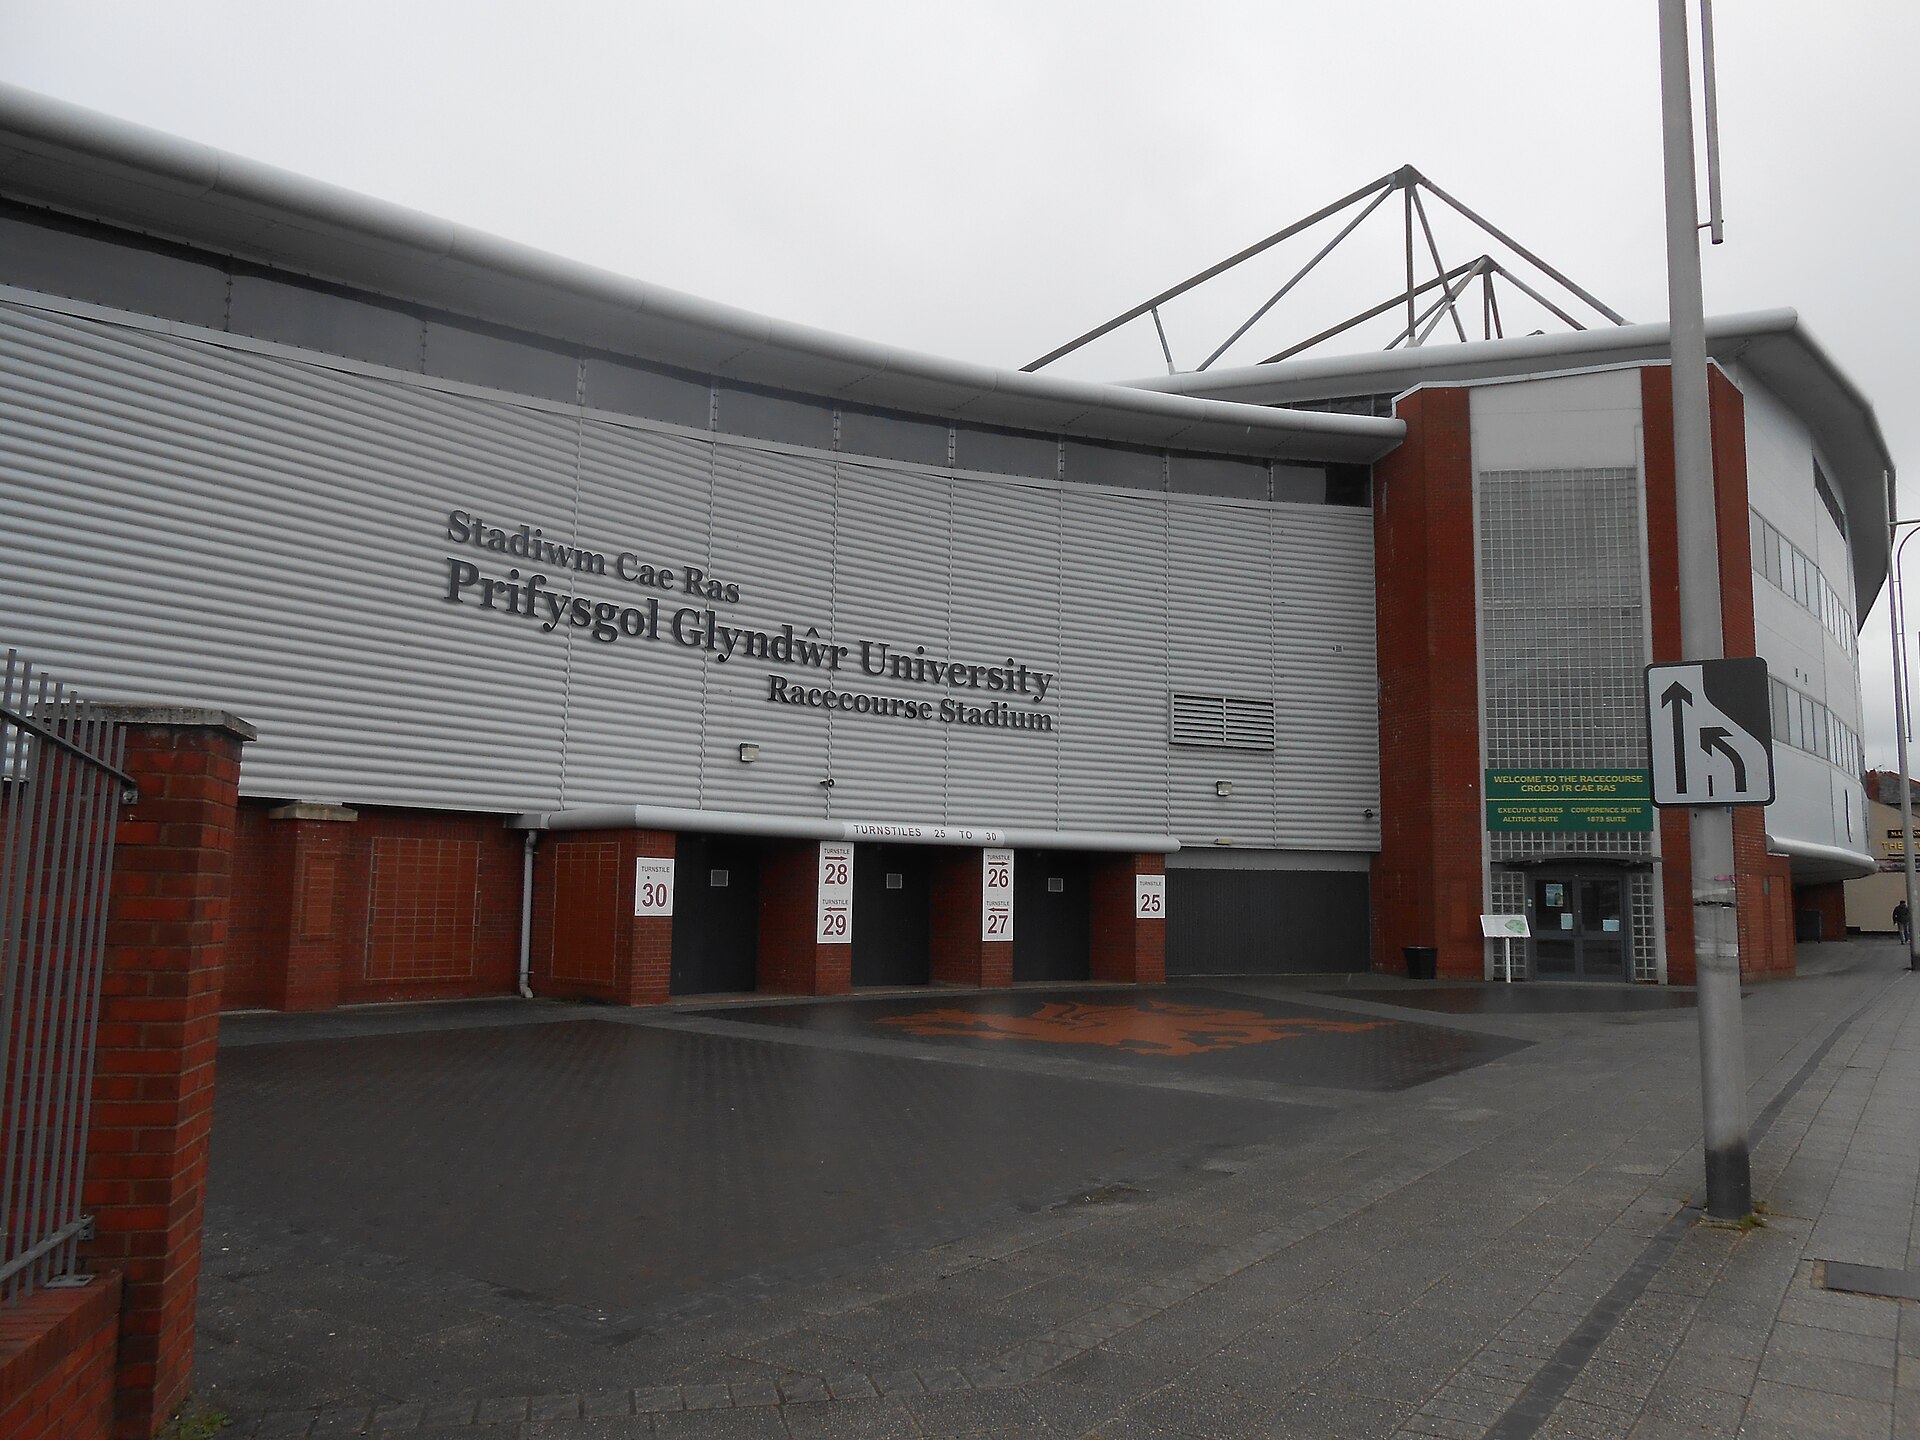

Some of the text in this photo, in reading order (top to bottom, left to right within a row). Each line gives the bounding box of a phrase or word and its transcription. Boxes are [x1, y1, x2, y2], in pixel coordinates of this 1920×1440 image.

[447, 509, 740, 604] Stadiwm Cae Ras
[444, 556, 1053, 703] Prifysgol Glyndŵr University
[768, 674, 1053, 731] Racecourse Stadium
[1494, 775, 1643, 783] WELCOME TO THE RACECOURSE
[1521, 784, 1559, 792] CROESO
[1574, 784, 1594, 792] CAE
[1597, 784, 1616, 792] RAS
[853, 824, 997, 841] TURNSTILES 25 TO 30
[823, 847, 850, 855] TURNSTILE
[641, 865, 670, 873] TURNSTILE
[824, 863, 848, 885] 28
[987, 868, 1009, 888] 26
[641, 883, 668, 908] 30
[1140, 893, 1161, 912] 25
[823, 914, 847, 936] 29
[987, 914, 1009, 934] 27
